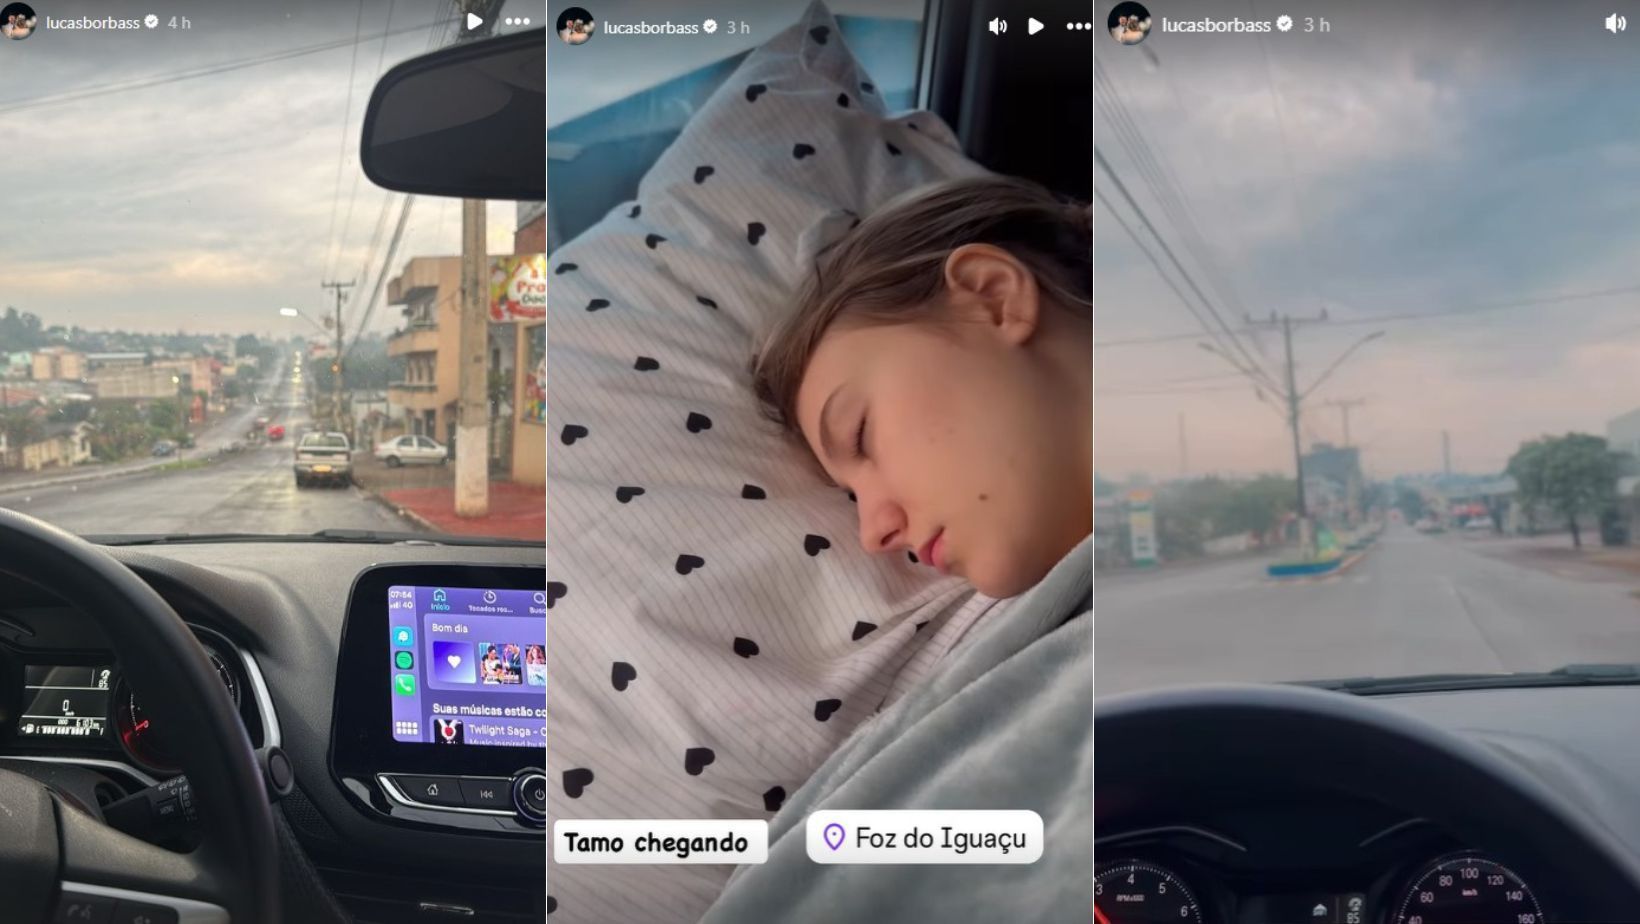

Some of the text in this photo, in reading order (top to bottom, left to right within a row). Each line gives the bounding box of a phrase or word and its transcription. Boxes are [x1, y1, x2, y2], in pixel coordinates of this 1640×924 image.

[432, 623, 468, 633] Bom dia
[433, 703, 458, 714] Suas
[460, 704, 502, 715] músicas
[504, 706, 534, 717] estão
[469, 724, 506, 737] Twilight
[506, 726, 531, 738] Saga
[1127, 873, 1135, 885] 4
[1459, 867, 1480, 879] 100
[1438, 875, 1453, 887] 80
[1487, 875, 1505, 886] 120
[1095, 883, 1103, 896] 3
[1158, 882, 1167, 894] 5
[1420, 891, 1435, 903] 60
[1505, 890, 1524, 902] 140
[1180, 904, 1189, 917] 6
[1408, 915, 1423, 924] 40
[1517, 913, 1535, 924] 160
